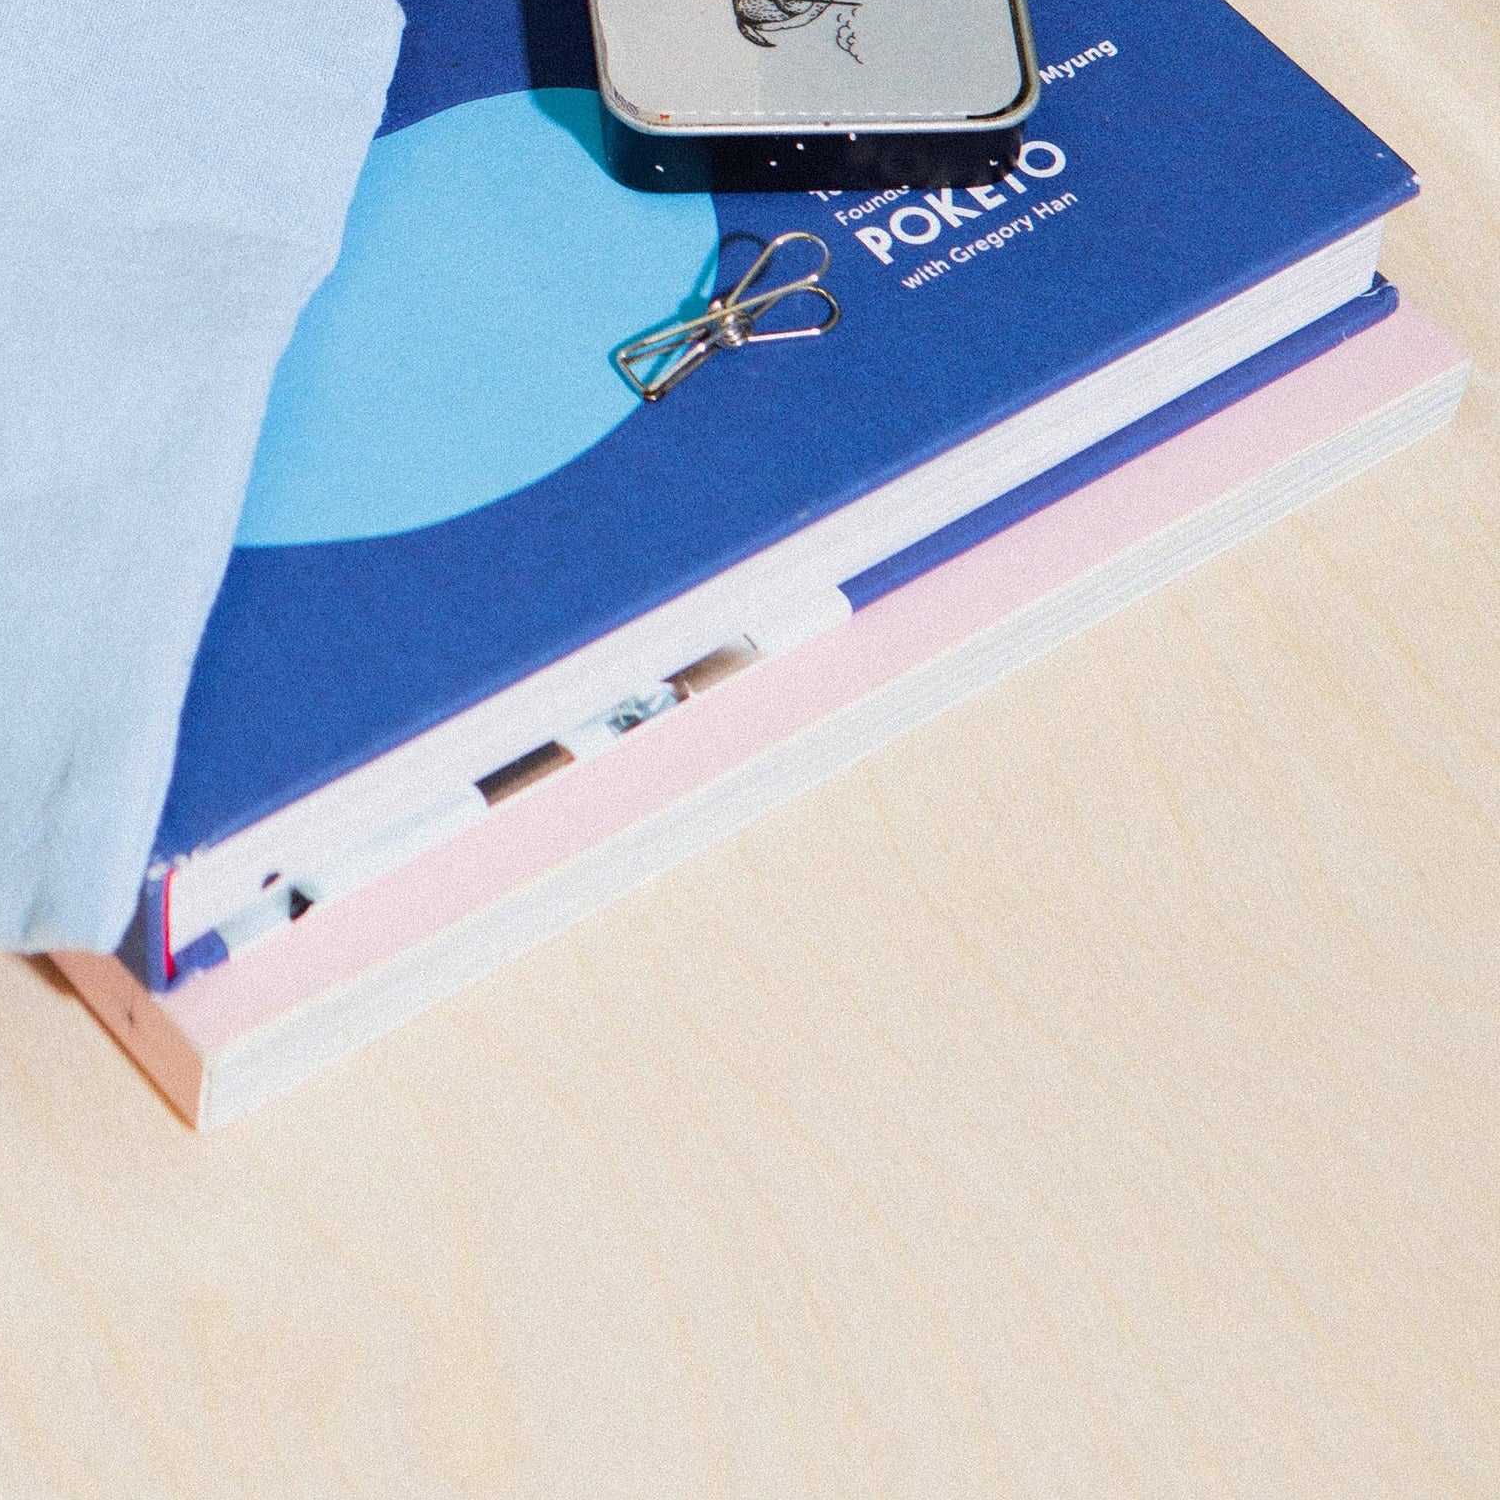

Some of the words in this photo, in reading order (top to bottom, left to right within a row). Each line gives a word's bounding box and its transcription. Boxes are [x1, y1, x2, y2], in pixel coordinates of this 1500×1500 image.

[1038, 39, 1118, 86] Myung
[901, 260, 951, 290] with
[948, 215, 1034, 264] Gregory
[1030, 192, 1079, 220] Han
